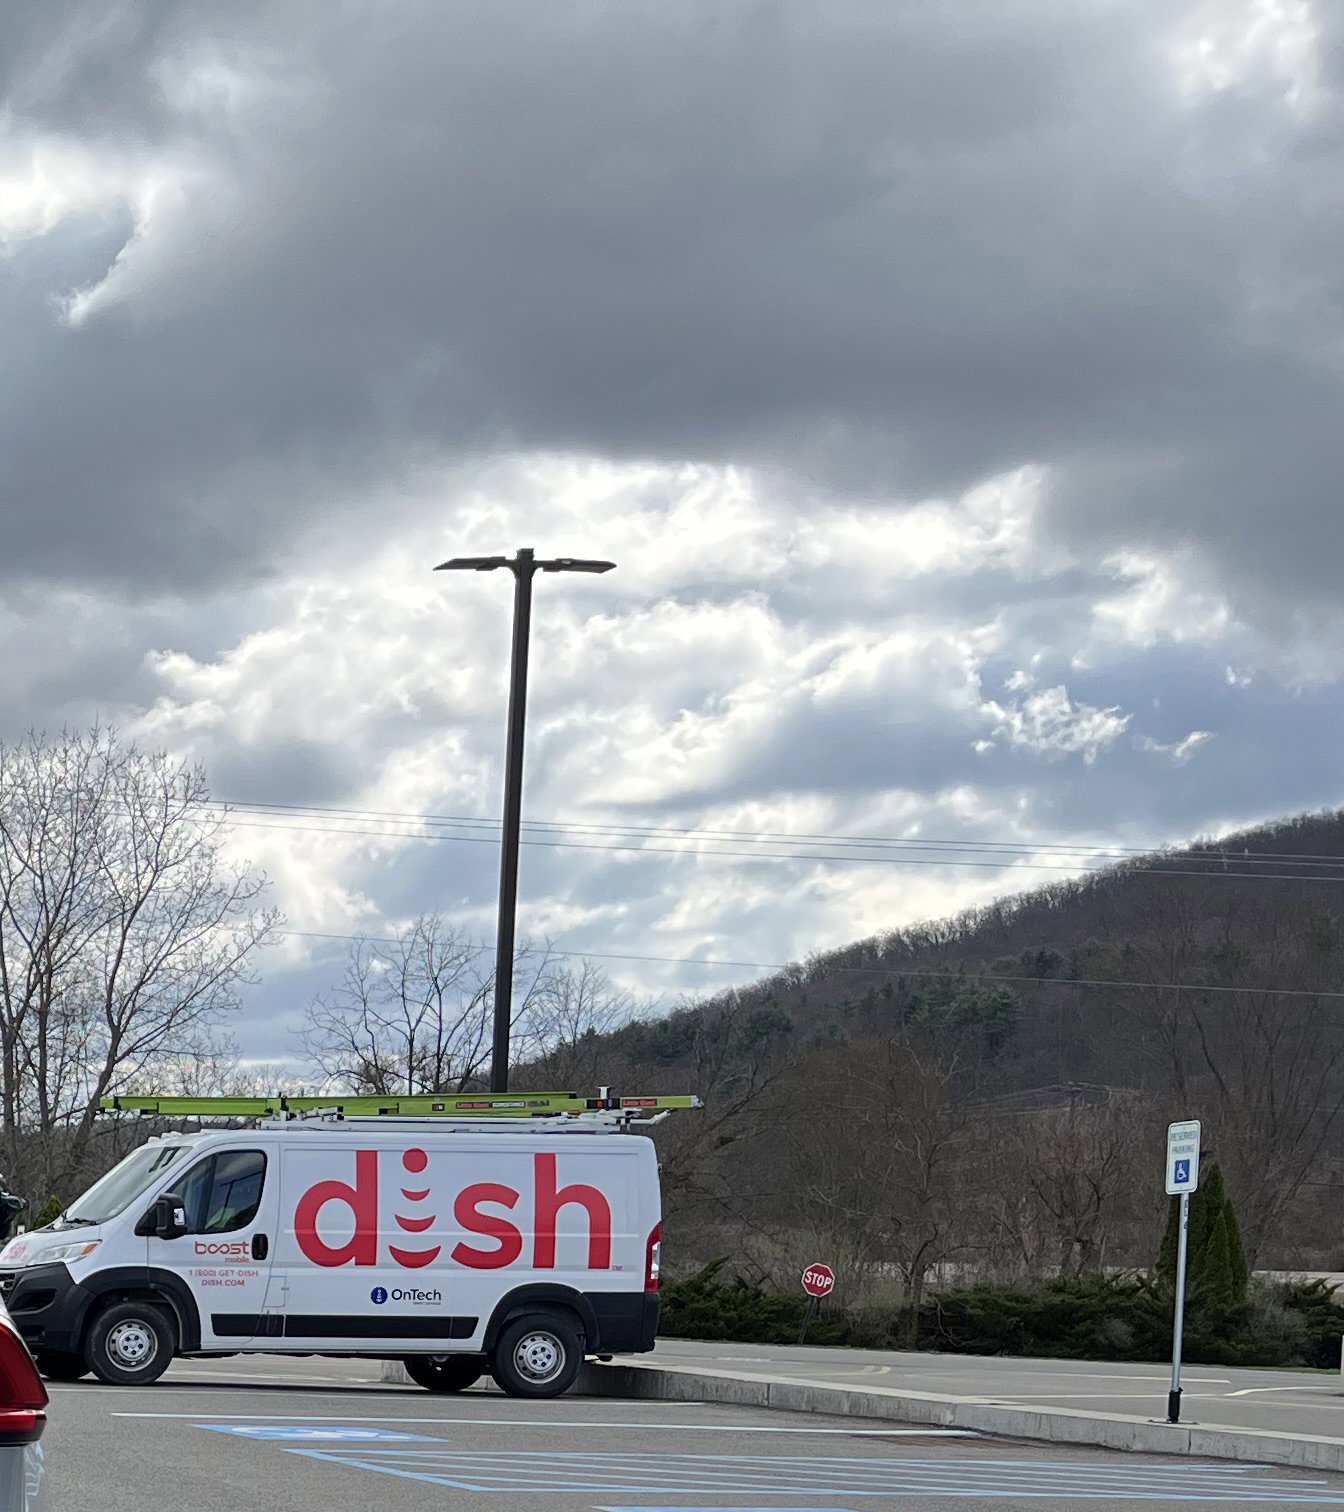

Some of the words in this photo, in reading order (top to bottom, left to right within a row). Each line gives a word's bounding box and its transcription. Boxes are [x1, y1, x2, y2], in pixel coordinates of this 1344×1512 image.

[294, 1147, 611, 1269] dish
[194, 1241, 249, 1255] boost
[804, 1271, 833, 1288] STOP
[391, 1289, 442, 1301] OnTech
